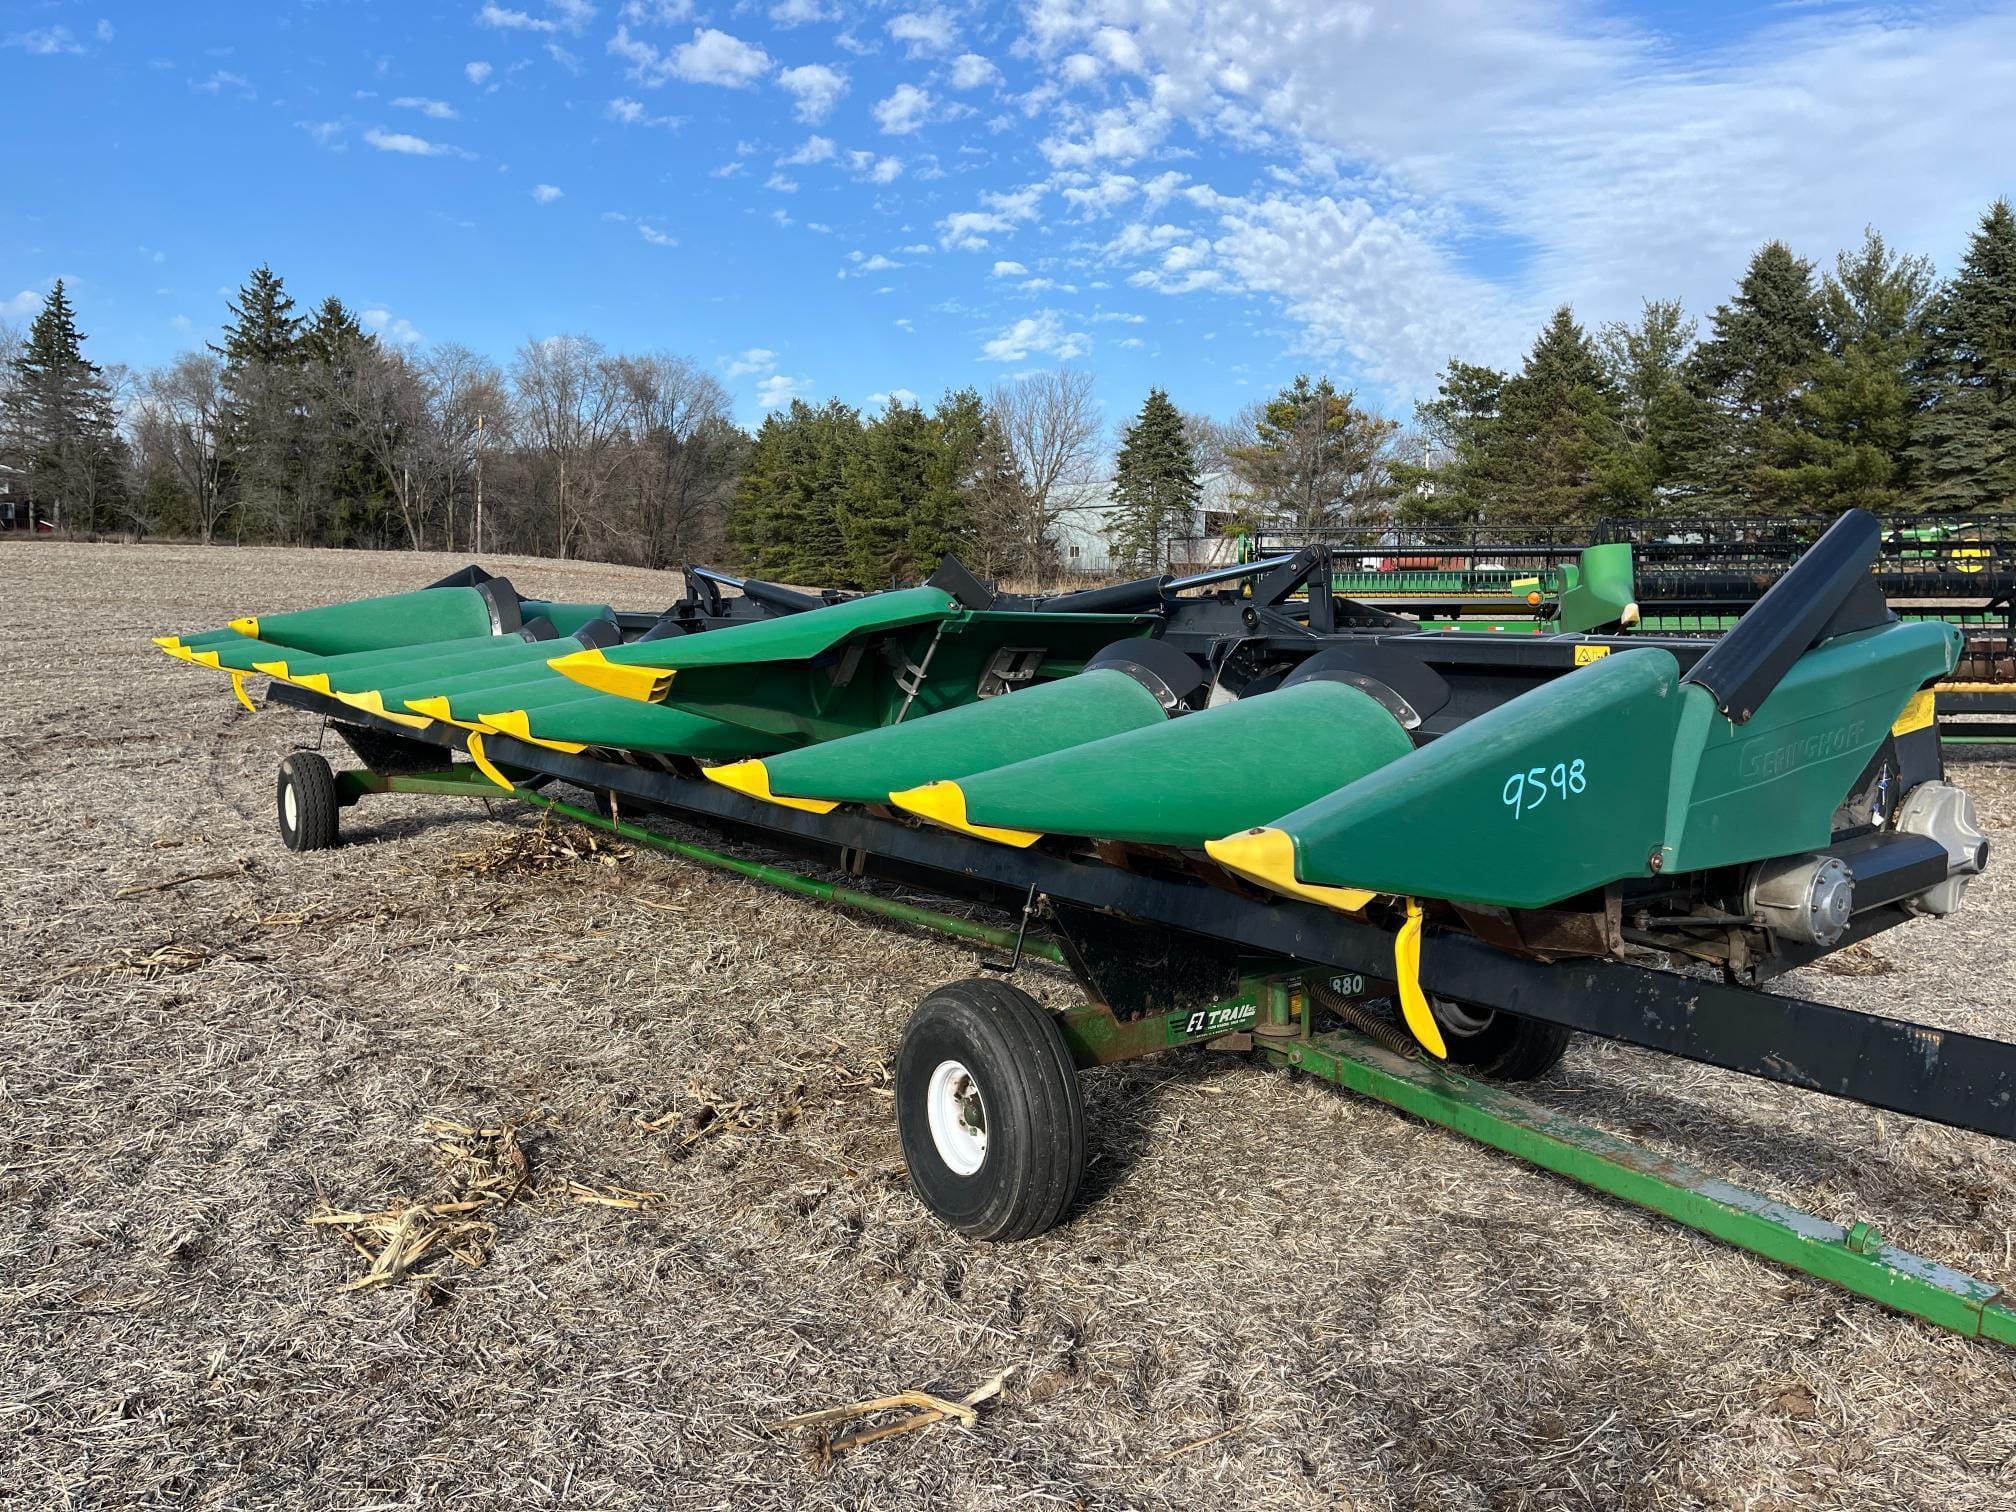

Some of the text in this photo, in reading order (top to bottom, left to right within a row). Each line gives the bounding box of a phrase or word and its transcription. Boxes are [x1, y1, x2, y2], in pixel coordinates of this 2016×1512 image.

[1503, 759, 1586, 820] 9598
[1332, 975, 1363, 996] 880
[1208, 1004, 1256, 1025] TRAIL
